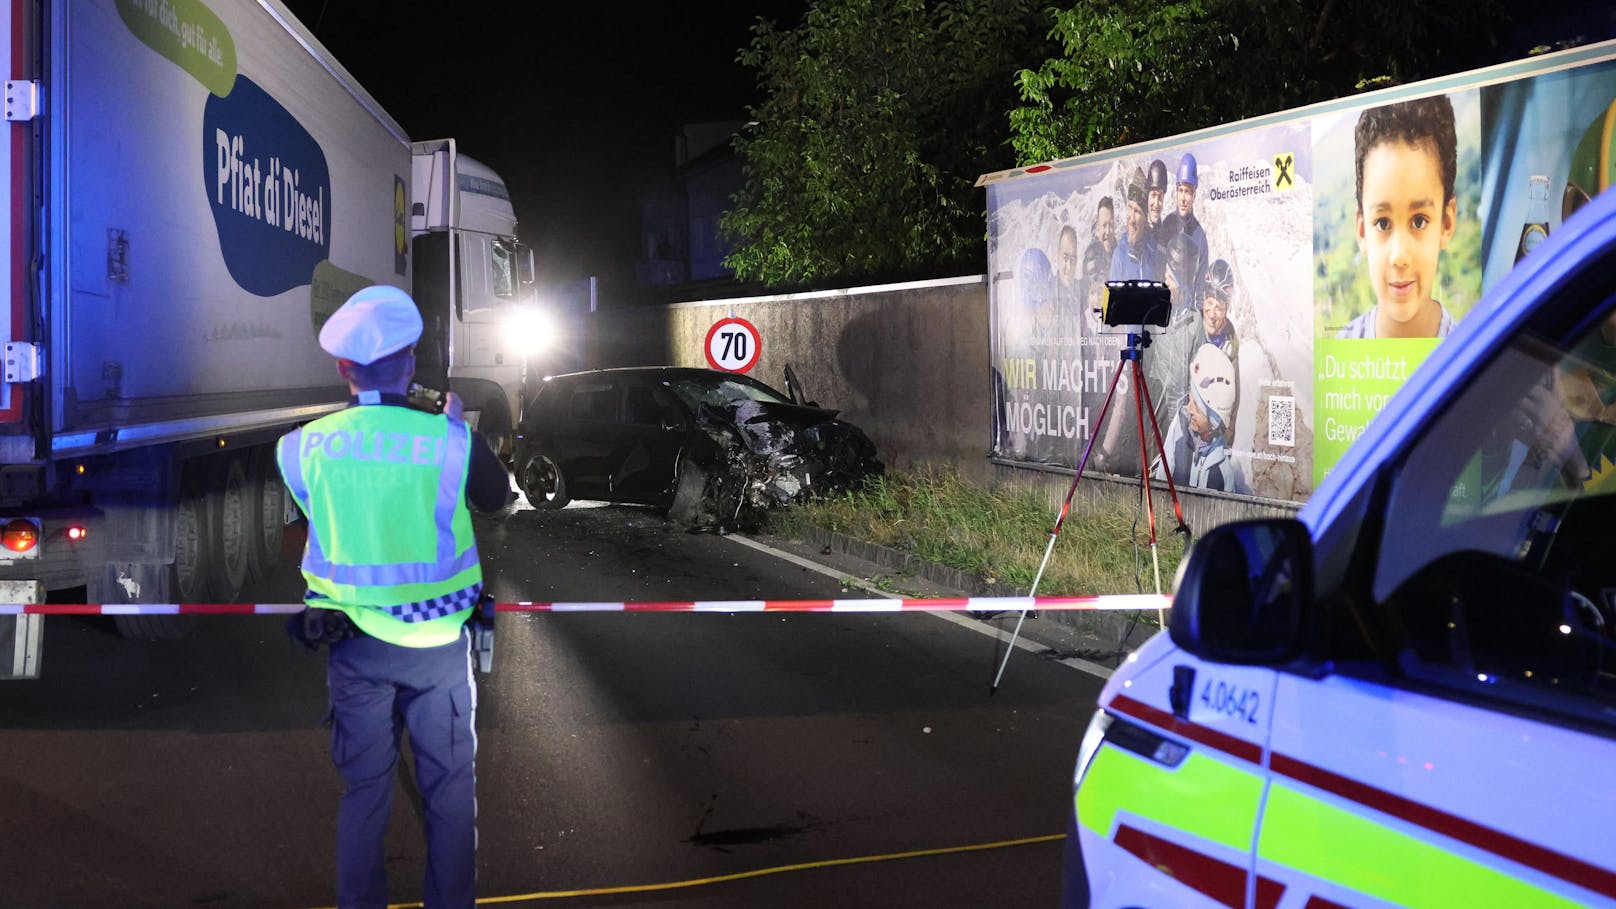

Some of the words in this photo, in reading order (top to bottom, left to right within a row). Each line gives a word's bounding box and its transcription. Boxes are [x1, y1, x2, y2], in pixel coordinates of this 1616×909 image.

[216, 127, 261, 220] Pfiat
[264, 157, 280, 227] di
[283, 166, 324, 246] Diesel
[1229, 165, 1271, 183] Raiffeisen
[1209, 179, 1271, 201] Oberösterreich
[721, 332, 747, 361] 70
[1004, 358, 1037, 390] WIR
[1350, 355, 1407, 381] schützt
[1325, 387, 1362, 410] mich
[1364, 393, 1390, 411] vor
[303, 429, 443, 467] POLIZEI
[1201, 679, 1260, 725] 4.0642
